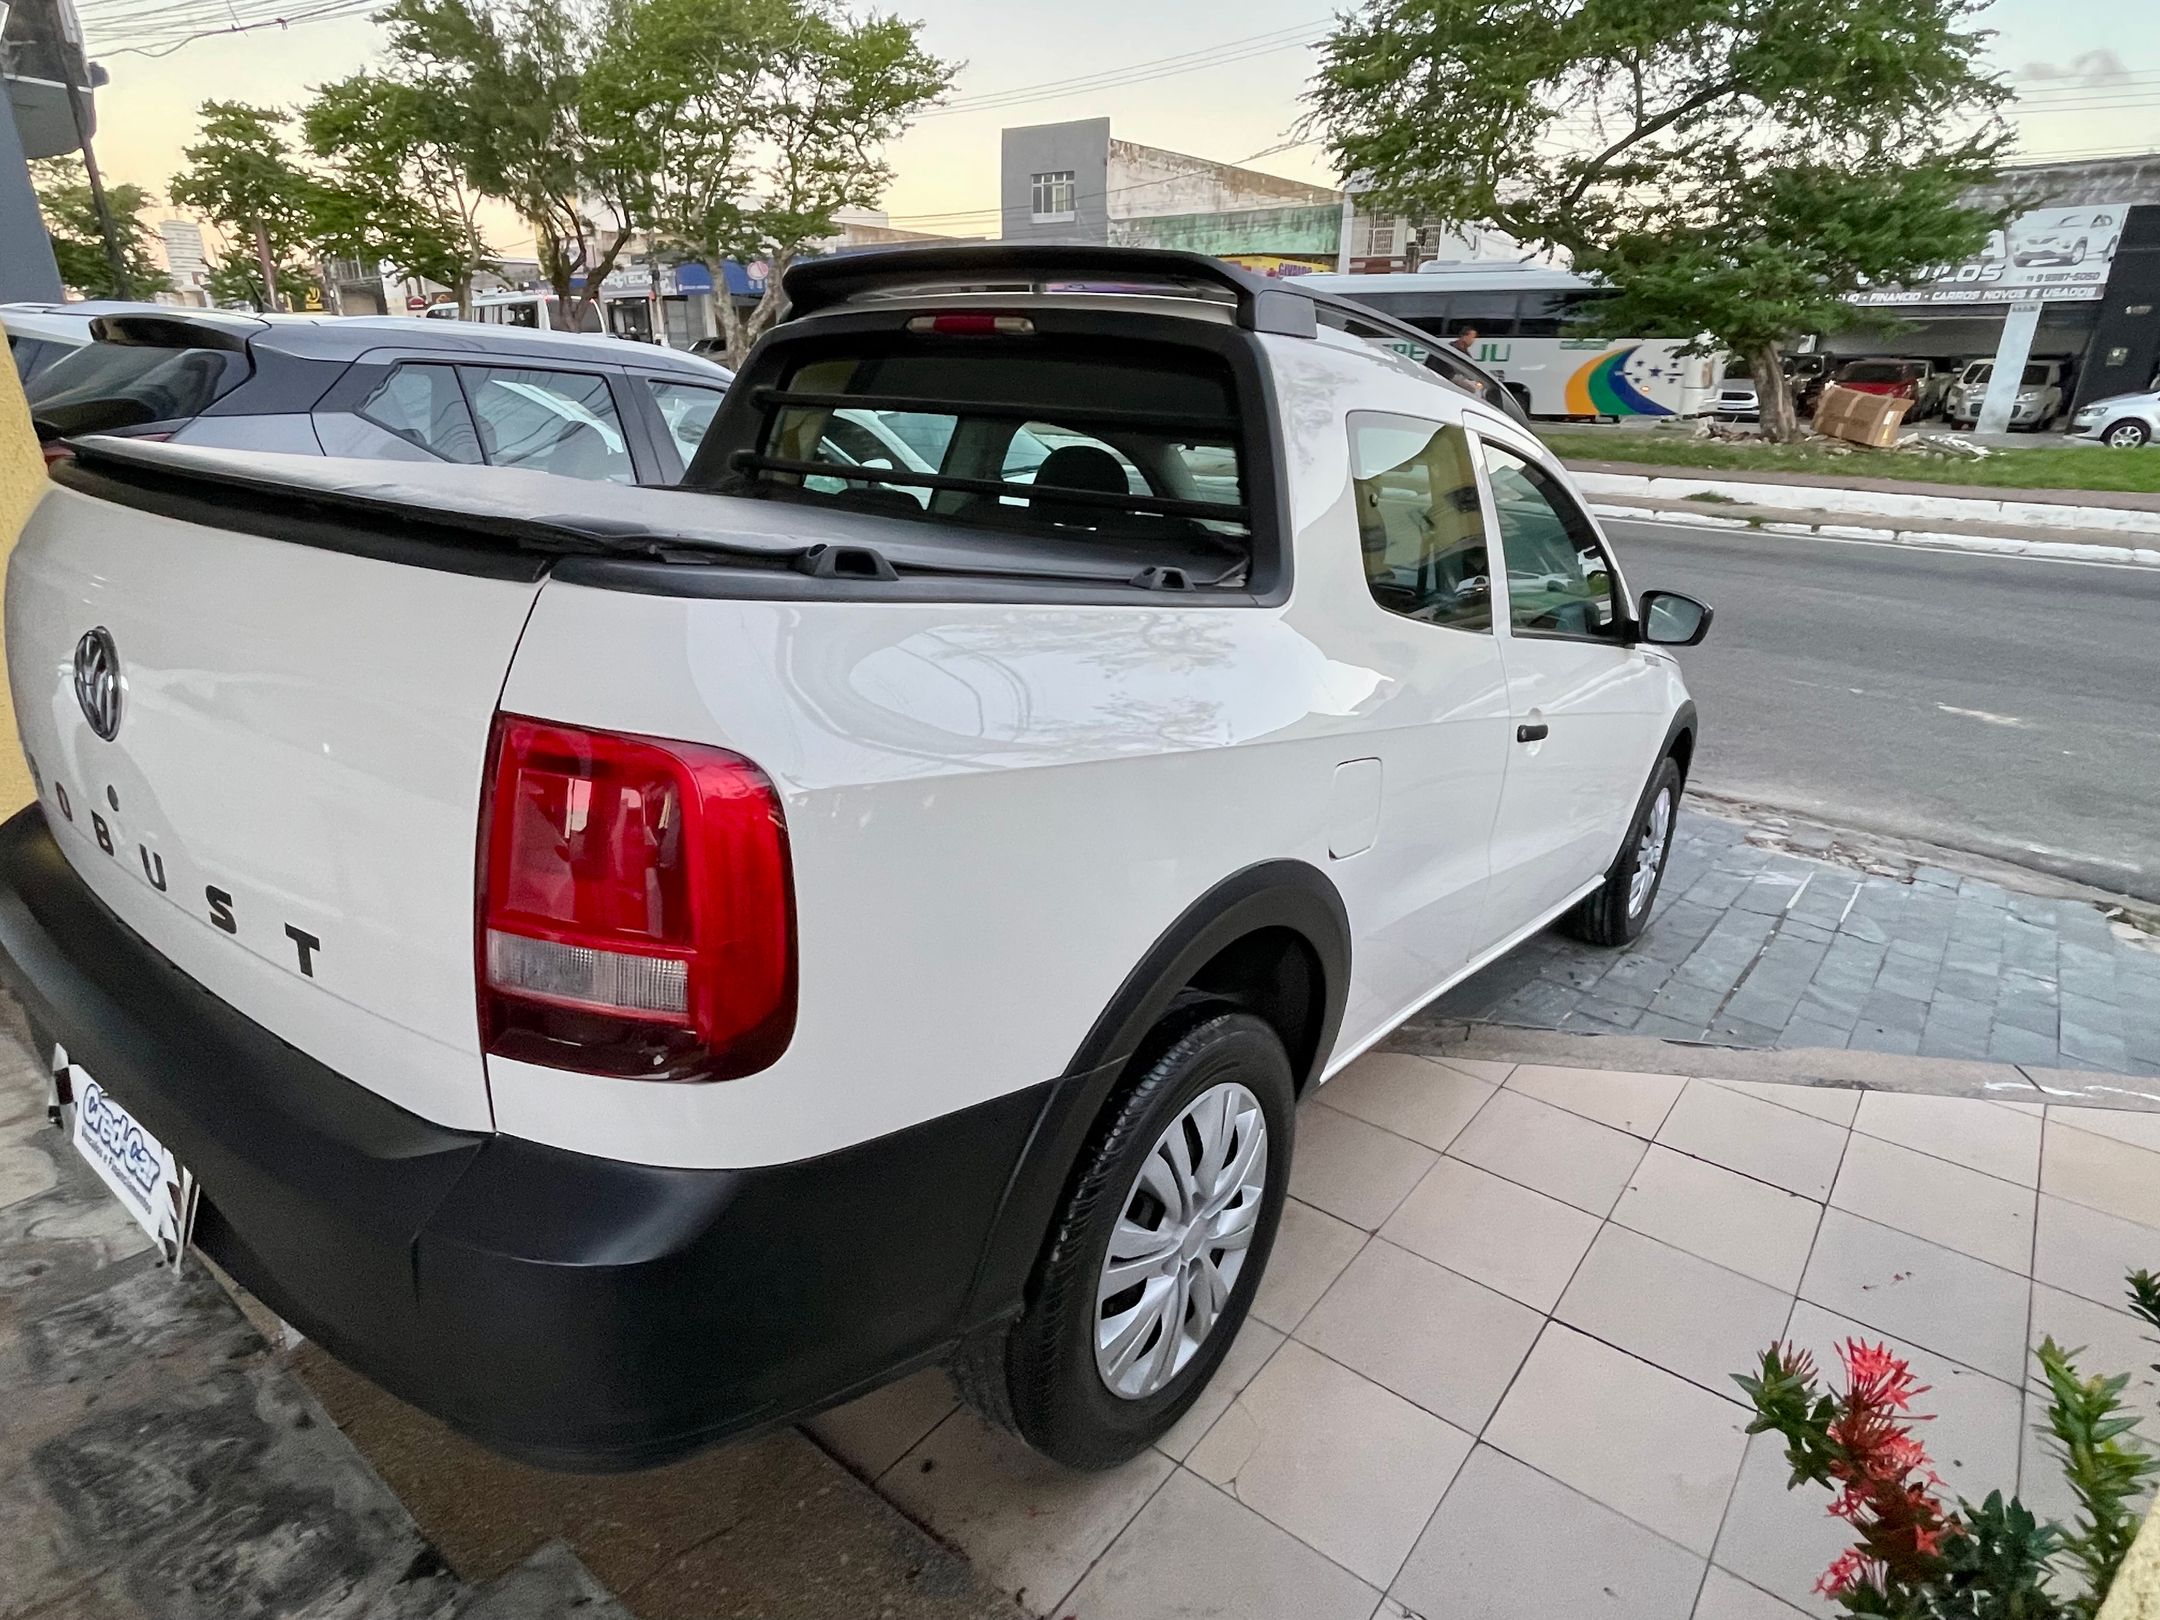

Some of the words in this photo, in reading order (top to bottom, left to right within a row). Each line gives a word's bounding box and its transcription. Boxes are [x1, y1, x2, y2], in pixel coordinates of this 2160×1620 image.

[1932, 290, 1981, 301] CARROS
[1983, 289, 2027, 299] NOVOS
[2030, 288, 2039, 298] E
[2042, 287, 2097, 297] USADOS
